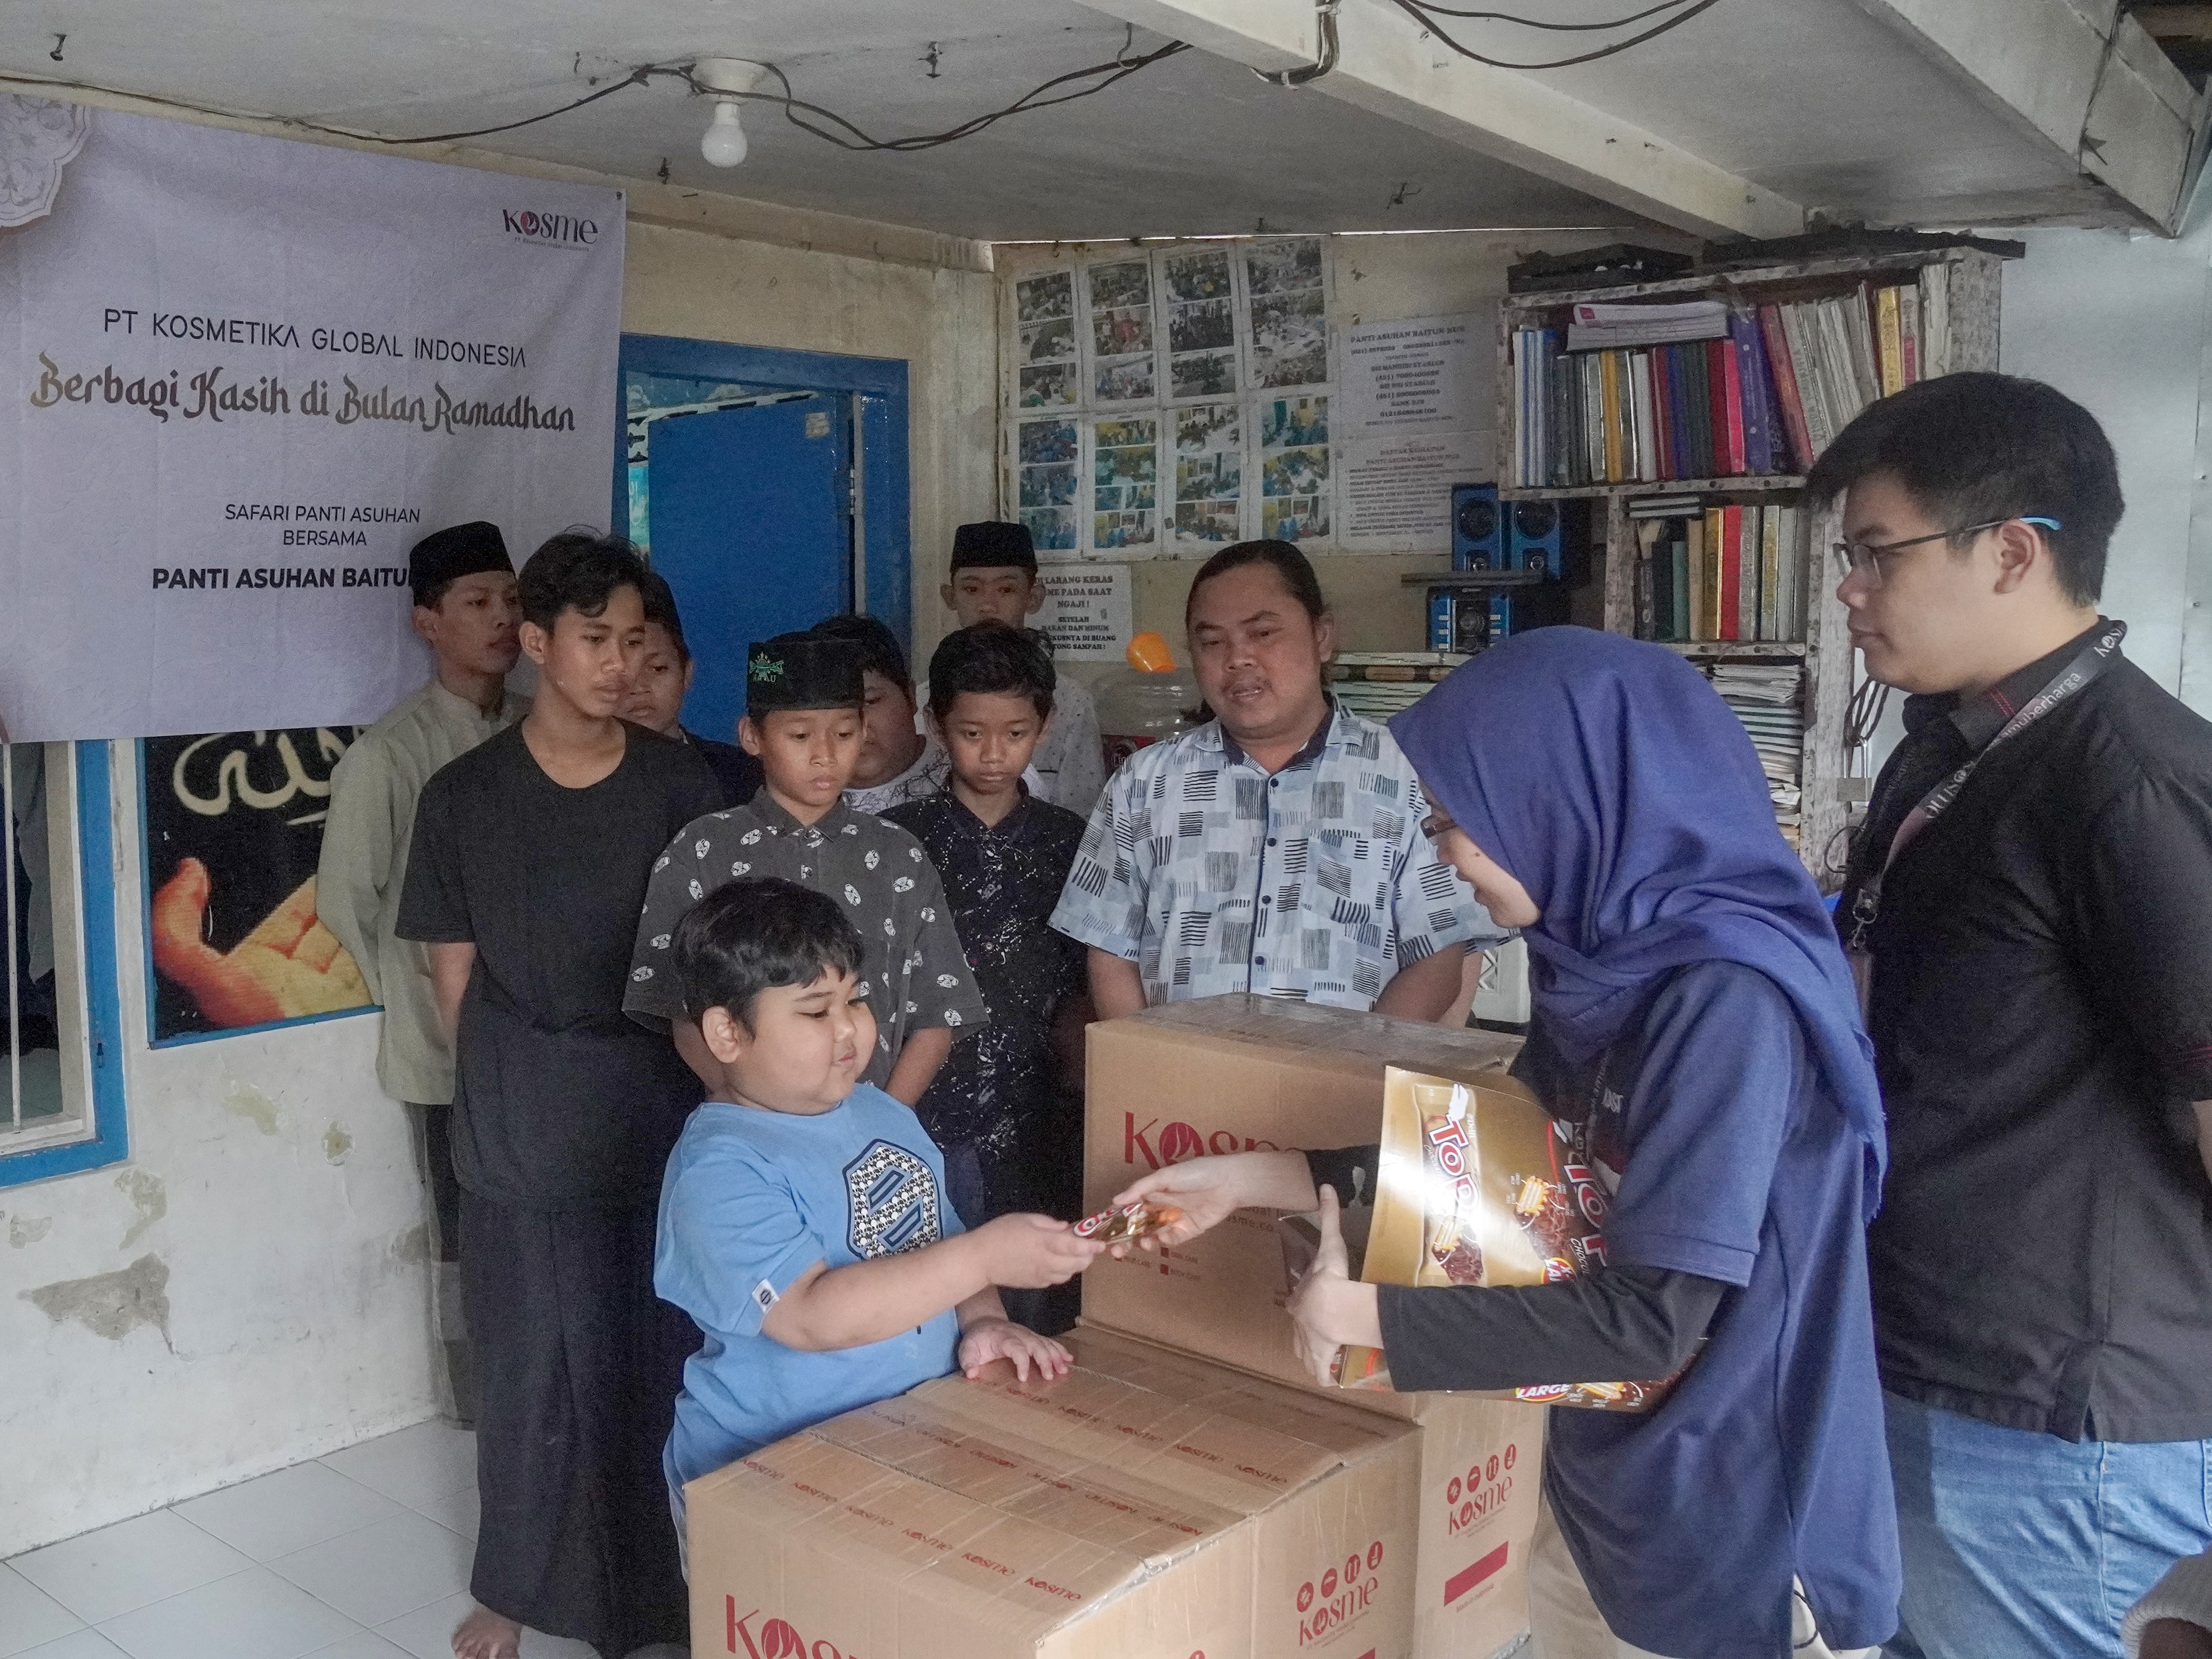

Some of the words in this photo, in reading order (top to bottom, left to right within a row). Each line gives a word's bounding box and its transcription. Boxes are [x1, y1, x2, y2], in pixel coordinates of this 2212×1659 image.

[105, 308, 138, 334] PT
[153, 313, 300, 348] KOSMETIKA
[312, 328, 403, 357] GLOBAL
[415, 337, 525, 368] INDONESIA
[30, 351, 179, 424] Berbagi
[183, 366, 291, 423] Kasih
[300, 379, 330, 416] di
[335, 372, 427, 425] Bulan
[423, 381, 575, 435] Ramadhan
[225, 504, 289, 521] SAFARI
[295, 506, 345, 522] PANTI
[350, 507, 420, 523] ASUHAN
[283, 530, 367, 546] BERSAMA
[152, 568, 229, 589] PANTI
[235, 568, 335, 589] ASUHAN
[1517, 1383, 1573, 1399] LARGE
